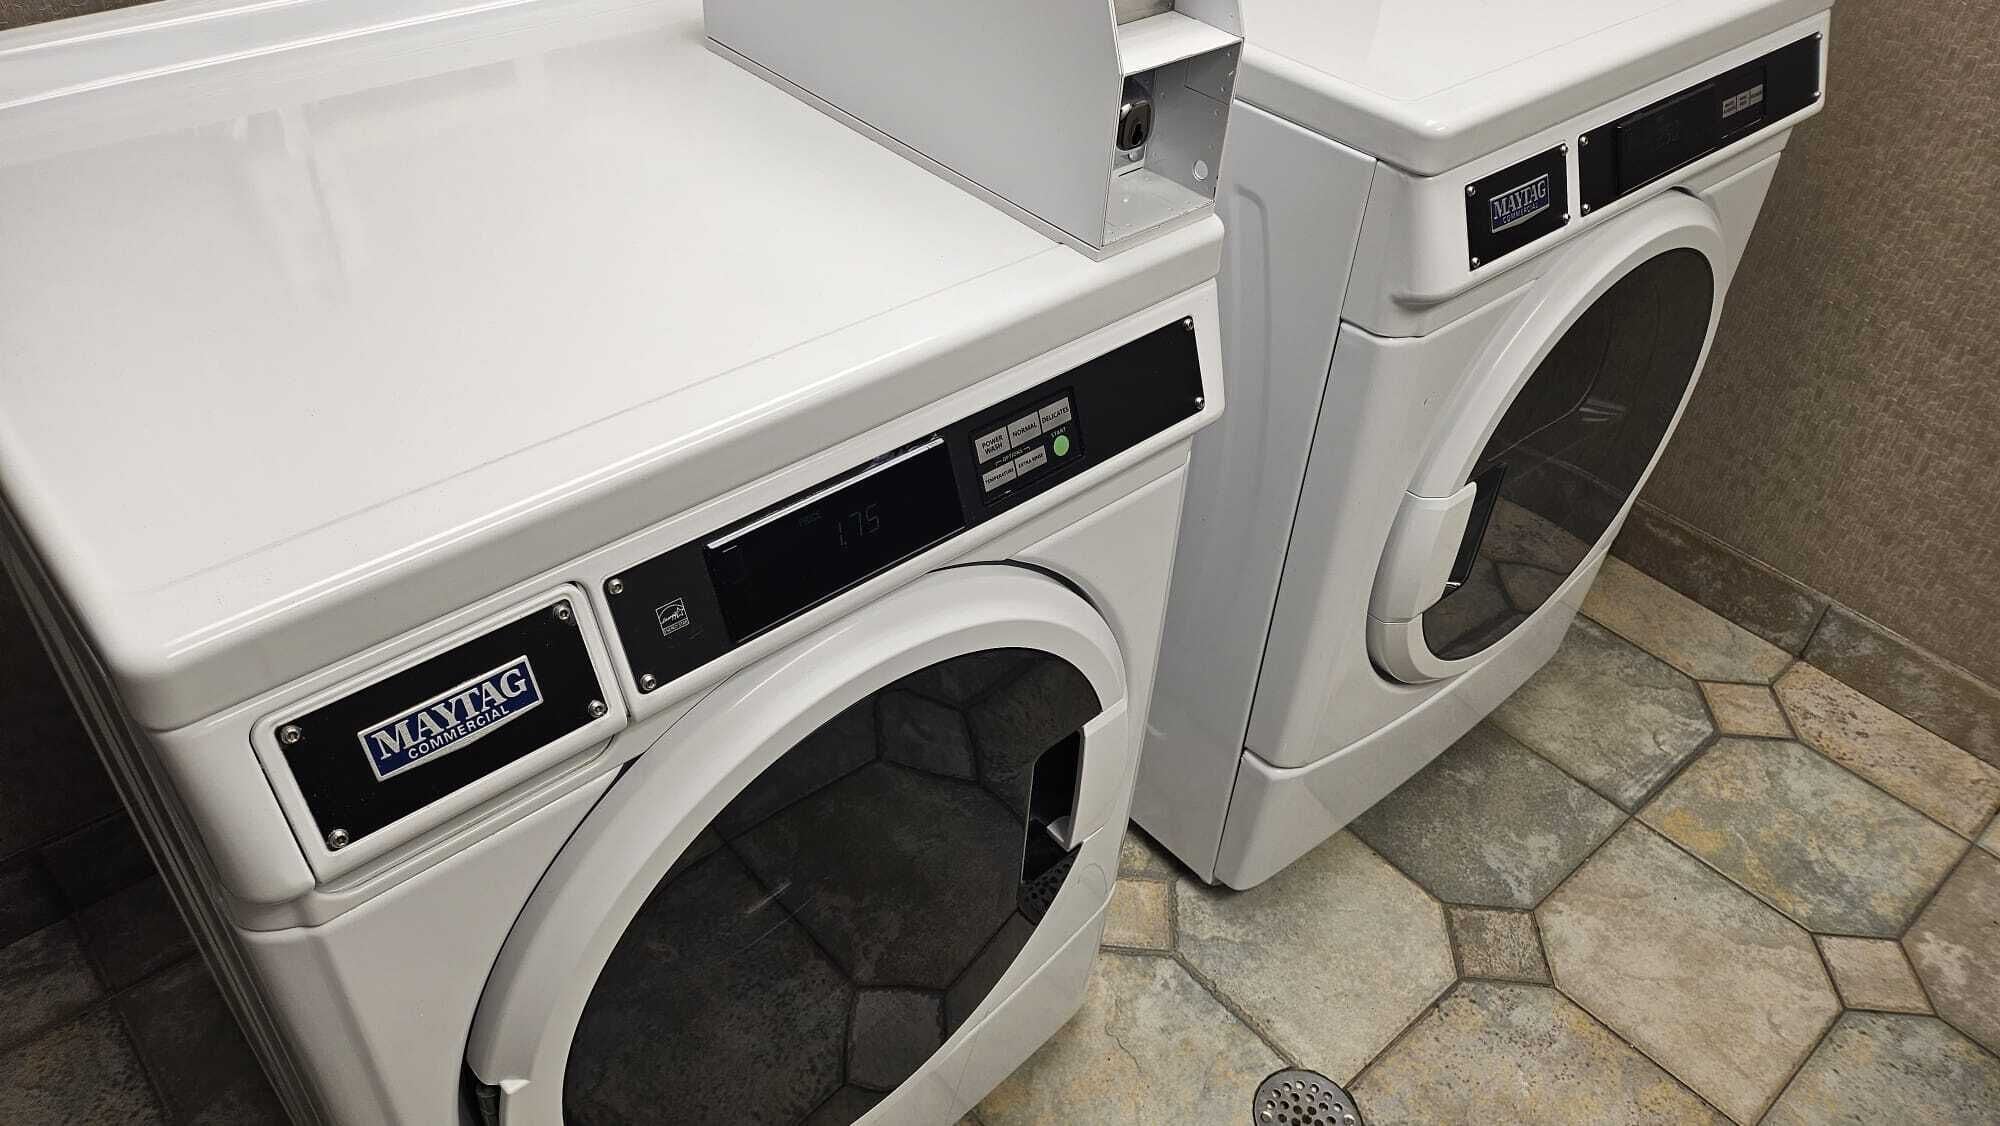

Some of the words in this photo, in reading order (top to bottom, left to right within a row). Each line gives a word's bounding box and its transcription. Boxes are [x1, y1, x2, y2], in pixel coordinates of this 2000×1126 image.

[1494, 180, 1546, 219] MAYTAG
[1041, 406, 1069, 424] DELICATES
[1012, 422, 1037, 437] NORMAL
[982, 434, 1004, 449] POWER
[984, 442, 1003, 455] WASH
[985, 467, 1014, 484] TEMPERATURE
[371, 668, 528, 761] MAYTAG
[408, 707, 510, 759] COMMERCIAL
